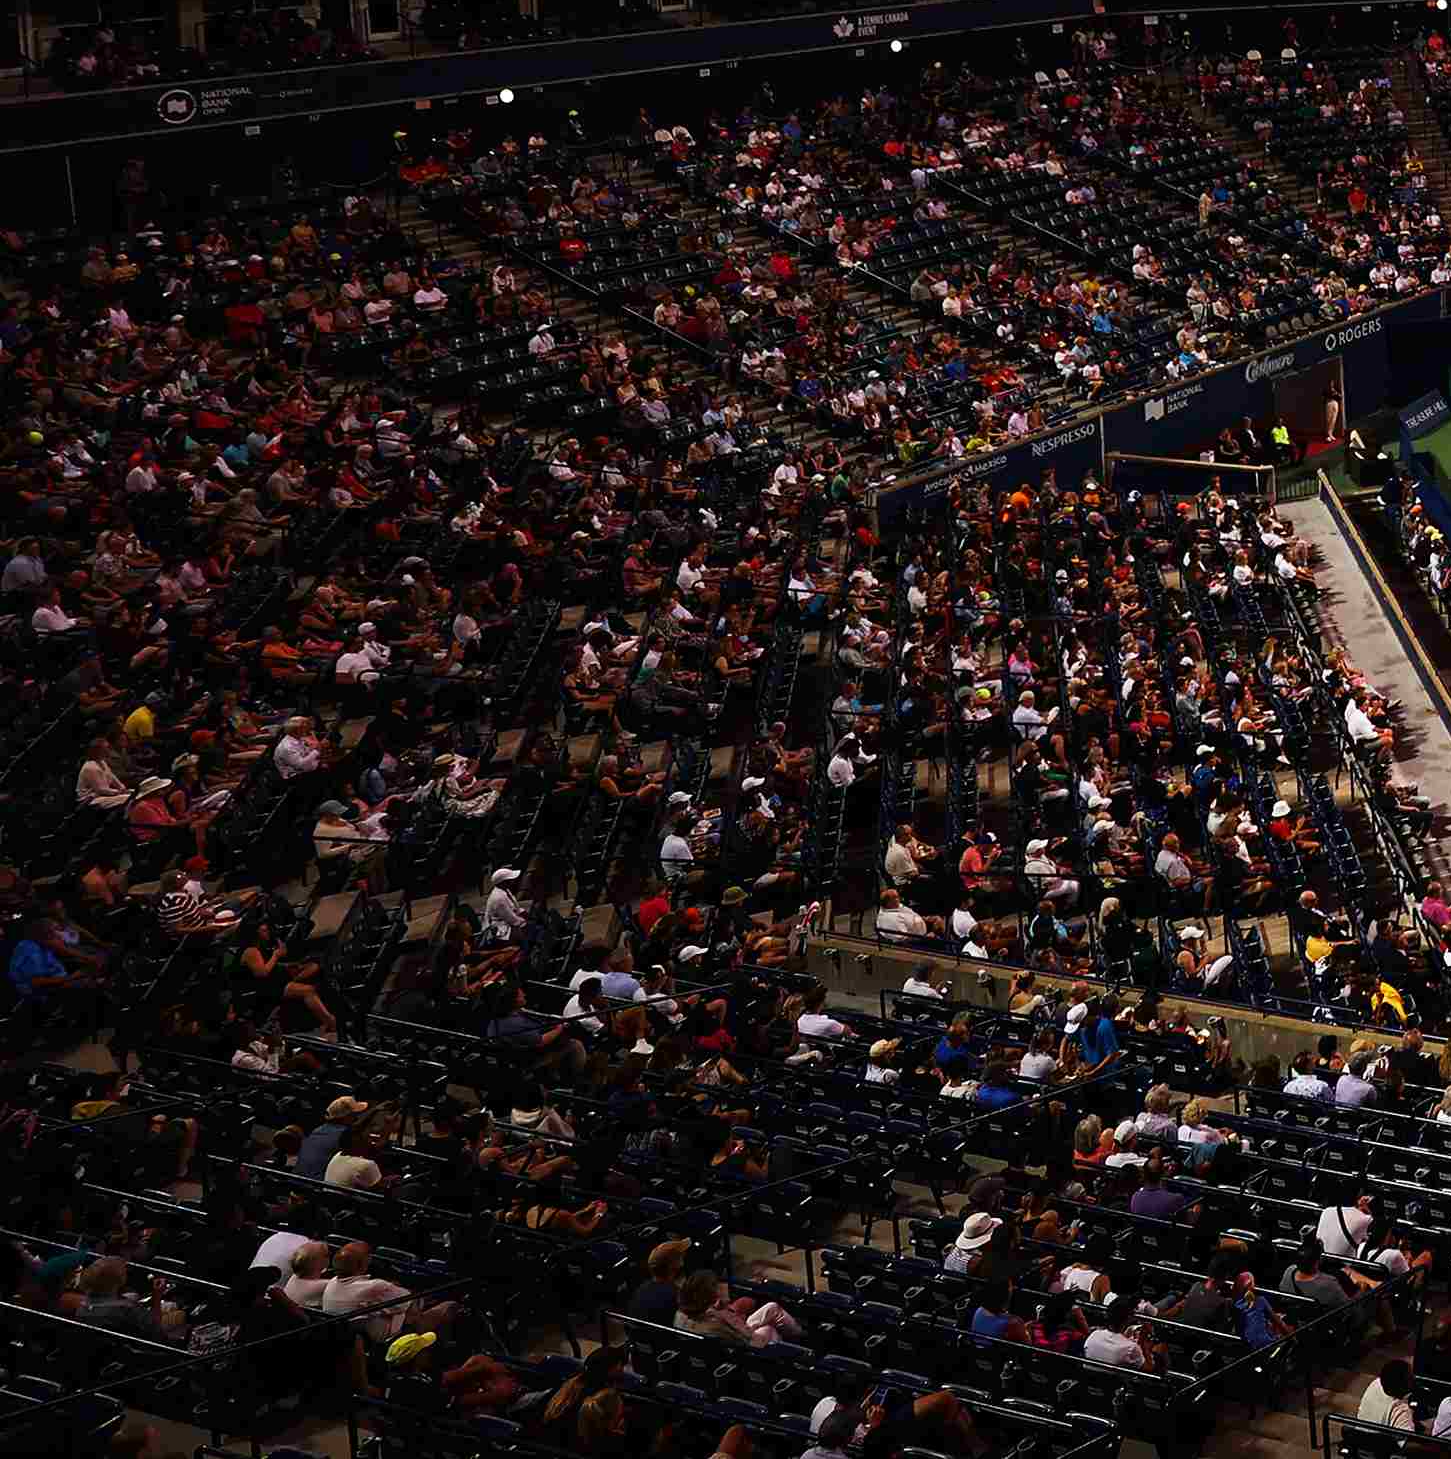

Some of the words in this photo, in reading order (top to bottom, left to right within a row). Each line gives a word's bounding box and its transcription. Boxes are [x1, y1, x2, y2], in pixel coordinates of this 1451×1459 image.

[201, 86, 252, 99] NATIONAL
[201, 97, 232, 108] BANK
[1338, 316, 1382, 347] ROGERS
[1167, 383, 1205, 401] NATIONAL
[1167, 399, 1190, 414] BANK
[1031, 423, 1096, 457] NESPRESSO
